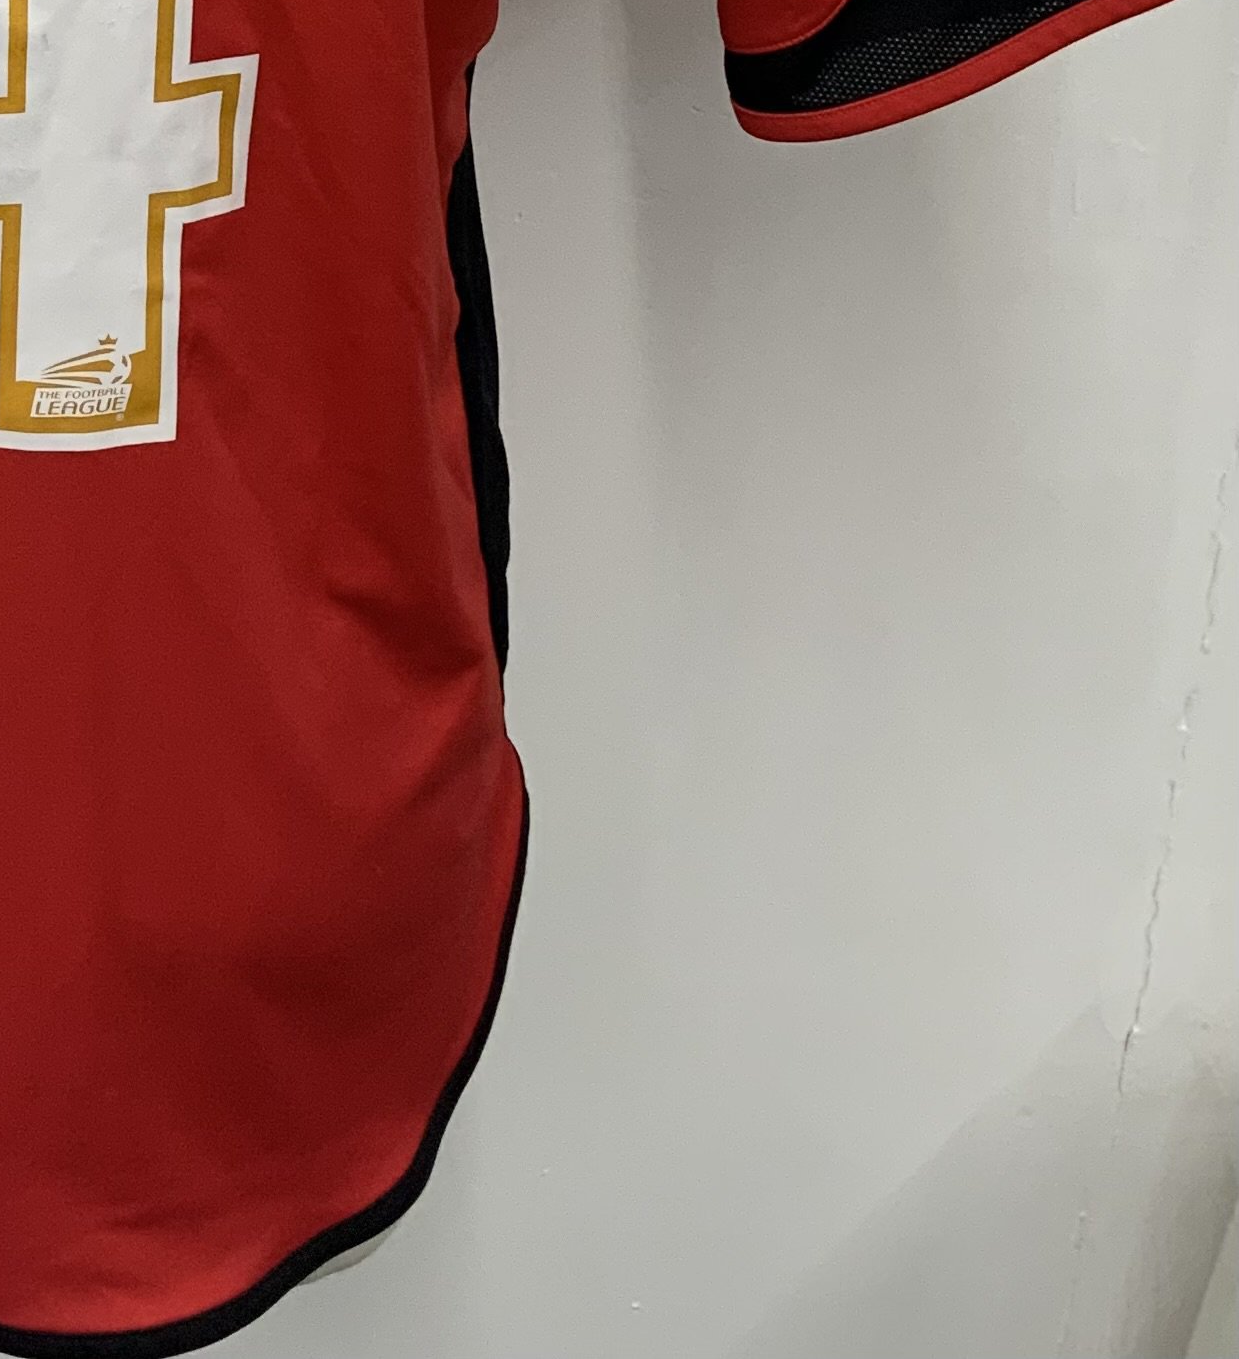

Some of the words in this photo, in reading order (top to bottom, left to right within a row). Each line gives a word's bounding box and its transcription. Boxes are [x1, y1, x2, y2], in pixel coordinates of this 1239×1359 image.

[39, 390, 61, 400] THE
[64, 386, 126, 400] FOOTBALL
[34, 396, 127, 416] LEAGUE
